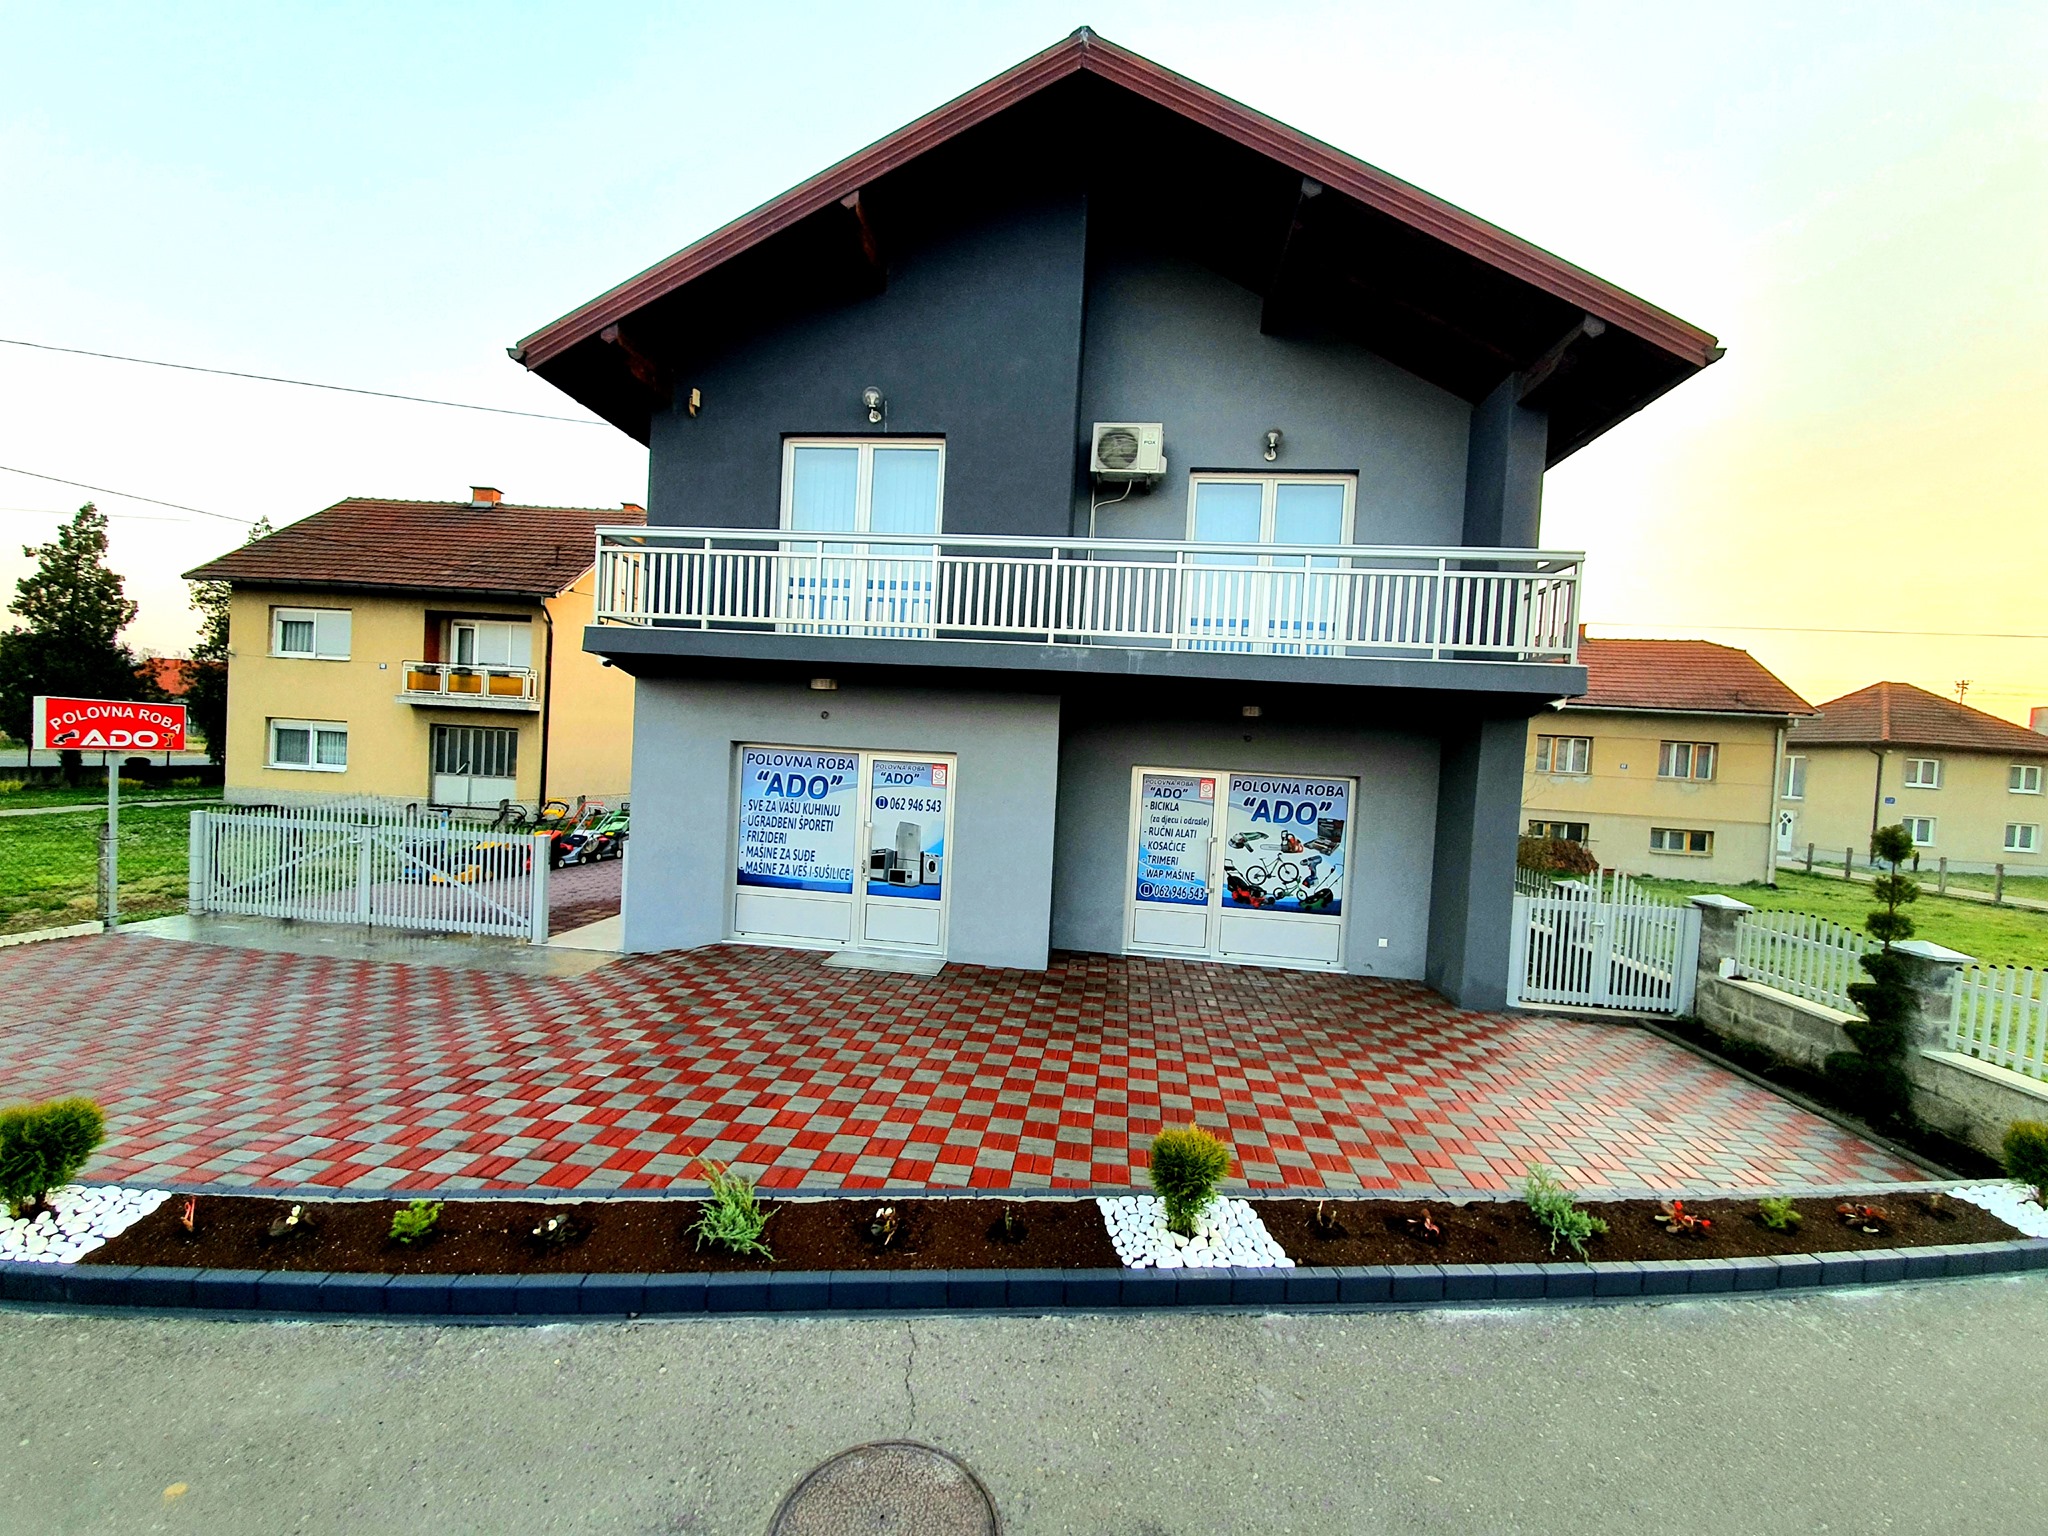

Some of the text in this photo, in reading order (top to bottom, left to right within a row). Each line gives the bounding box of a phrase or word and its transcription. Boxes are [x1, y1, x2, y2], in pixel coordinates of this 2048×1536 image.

[50, 706, 182, 734] POLOVNA ROBA
[80, 729, 159, 747] ADO
[746, 753, 854, 770] POLOVNA ROBA
[757, 770, 844, 800] “ADO”
[880, 772, 920, 784] “ADO”
[1150, 787, 1188, 799] “ADO”
[1233, 780, 1344, 797] POLOVNA ROBA
[748, 799, 841, 817] SVE ZA VAŠU KUHINJU
[890, 797, 941, 812] 062 946 543
[1150, 801, 1179, 811] BICIKLA
[1243, 797, 1332, 825] “ADO”
[748, 814, 834, 832] UGRADBENI ŠPORETI
[1161, 815, 1179, 825] djecu
[746, 828, 787, 844] FRIŽIDERI
[1175, 829, 1197, 838] ALATI
[746, 844, 815, 862] MAŠINE ZA SUĐE
[1147, 855, 1178, 866] TRIMERI
[745, 859, 776, 874] MAŠINE
[778, 864, 790, 875] ZA
[1146, 869, 1195, 880] WAP MAŠINE
[1154, 885, 1204, 899] 062 946 543
